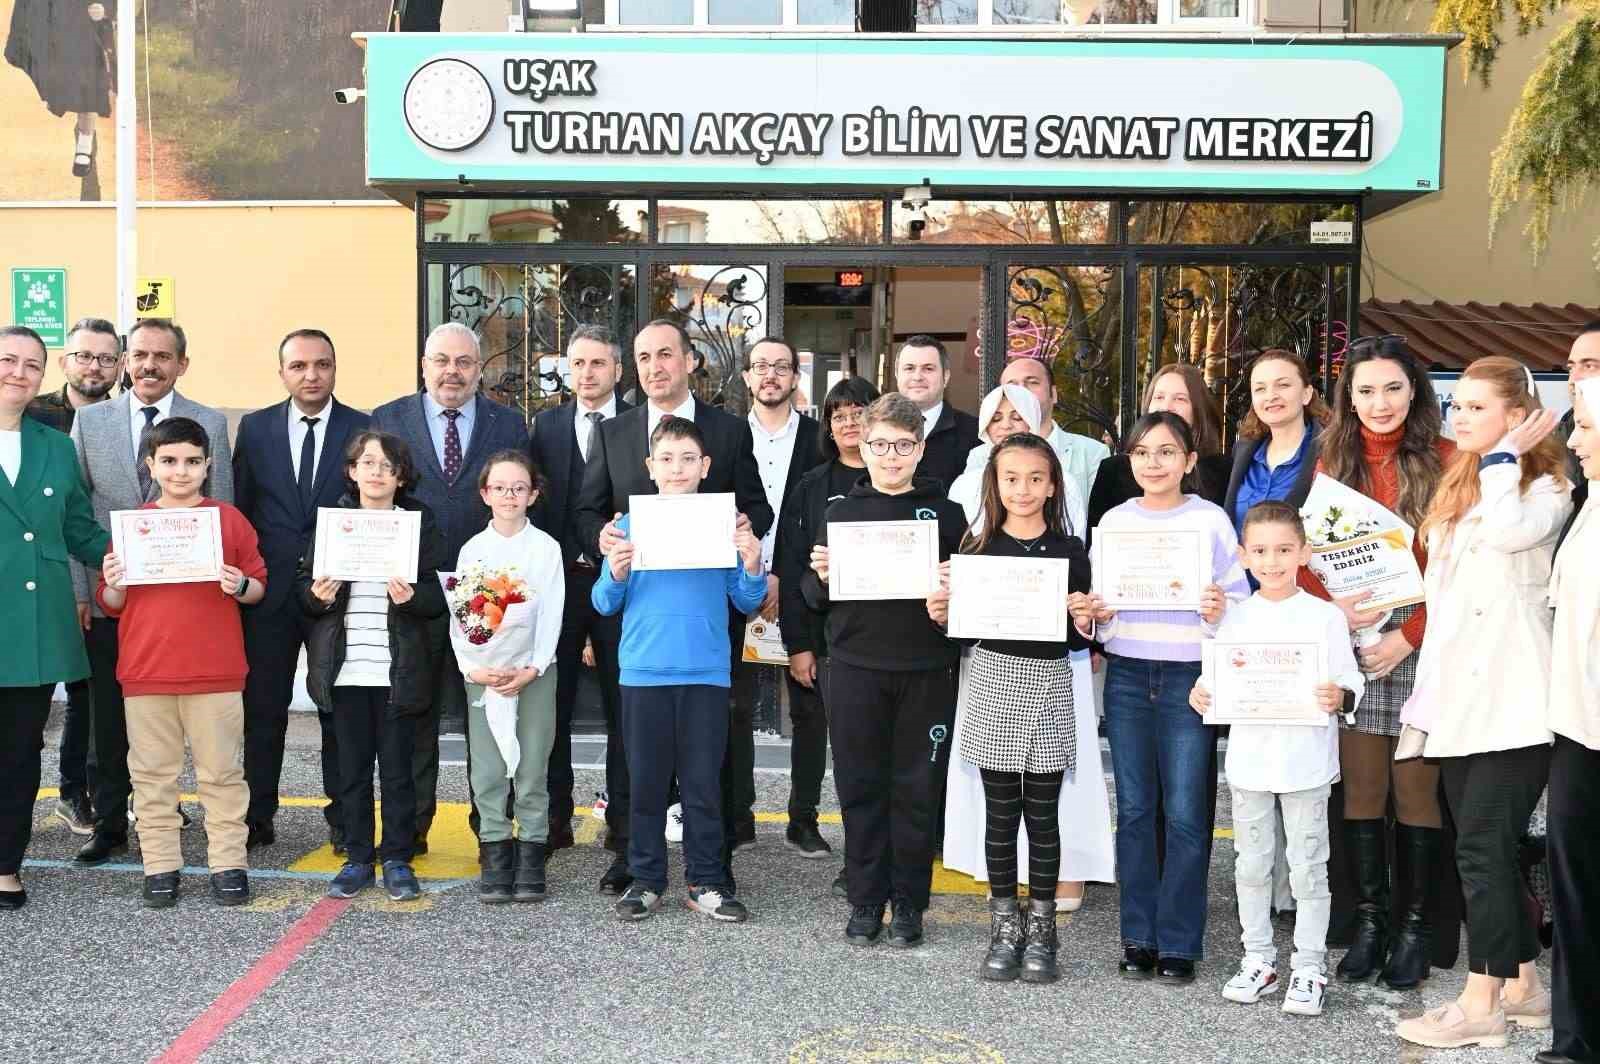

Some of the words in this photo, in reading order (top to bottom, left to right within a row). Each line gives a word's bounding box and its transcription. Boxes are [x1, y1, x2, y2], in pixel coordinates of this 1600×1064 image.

[504, 59, 596, 101] UŞAK
[505, 111, 683, 155] TURHAN
[691, 113, 833, 165] AKÇAY
[842, 106, 961, 157] BİLİM
[968, 115, 1027, 158] VE
[1036, 117, 1180, 160] SANAT
[1185, 111, 1373, 163] MERKEZİ
[1321, 542, 1380, 562] TEŞEKKÜR
[1333, 554, 1375, 570] EDERİZ
